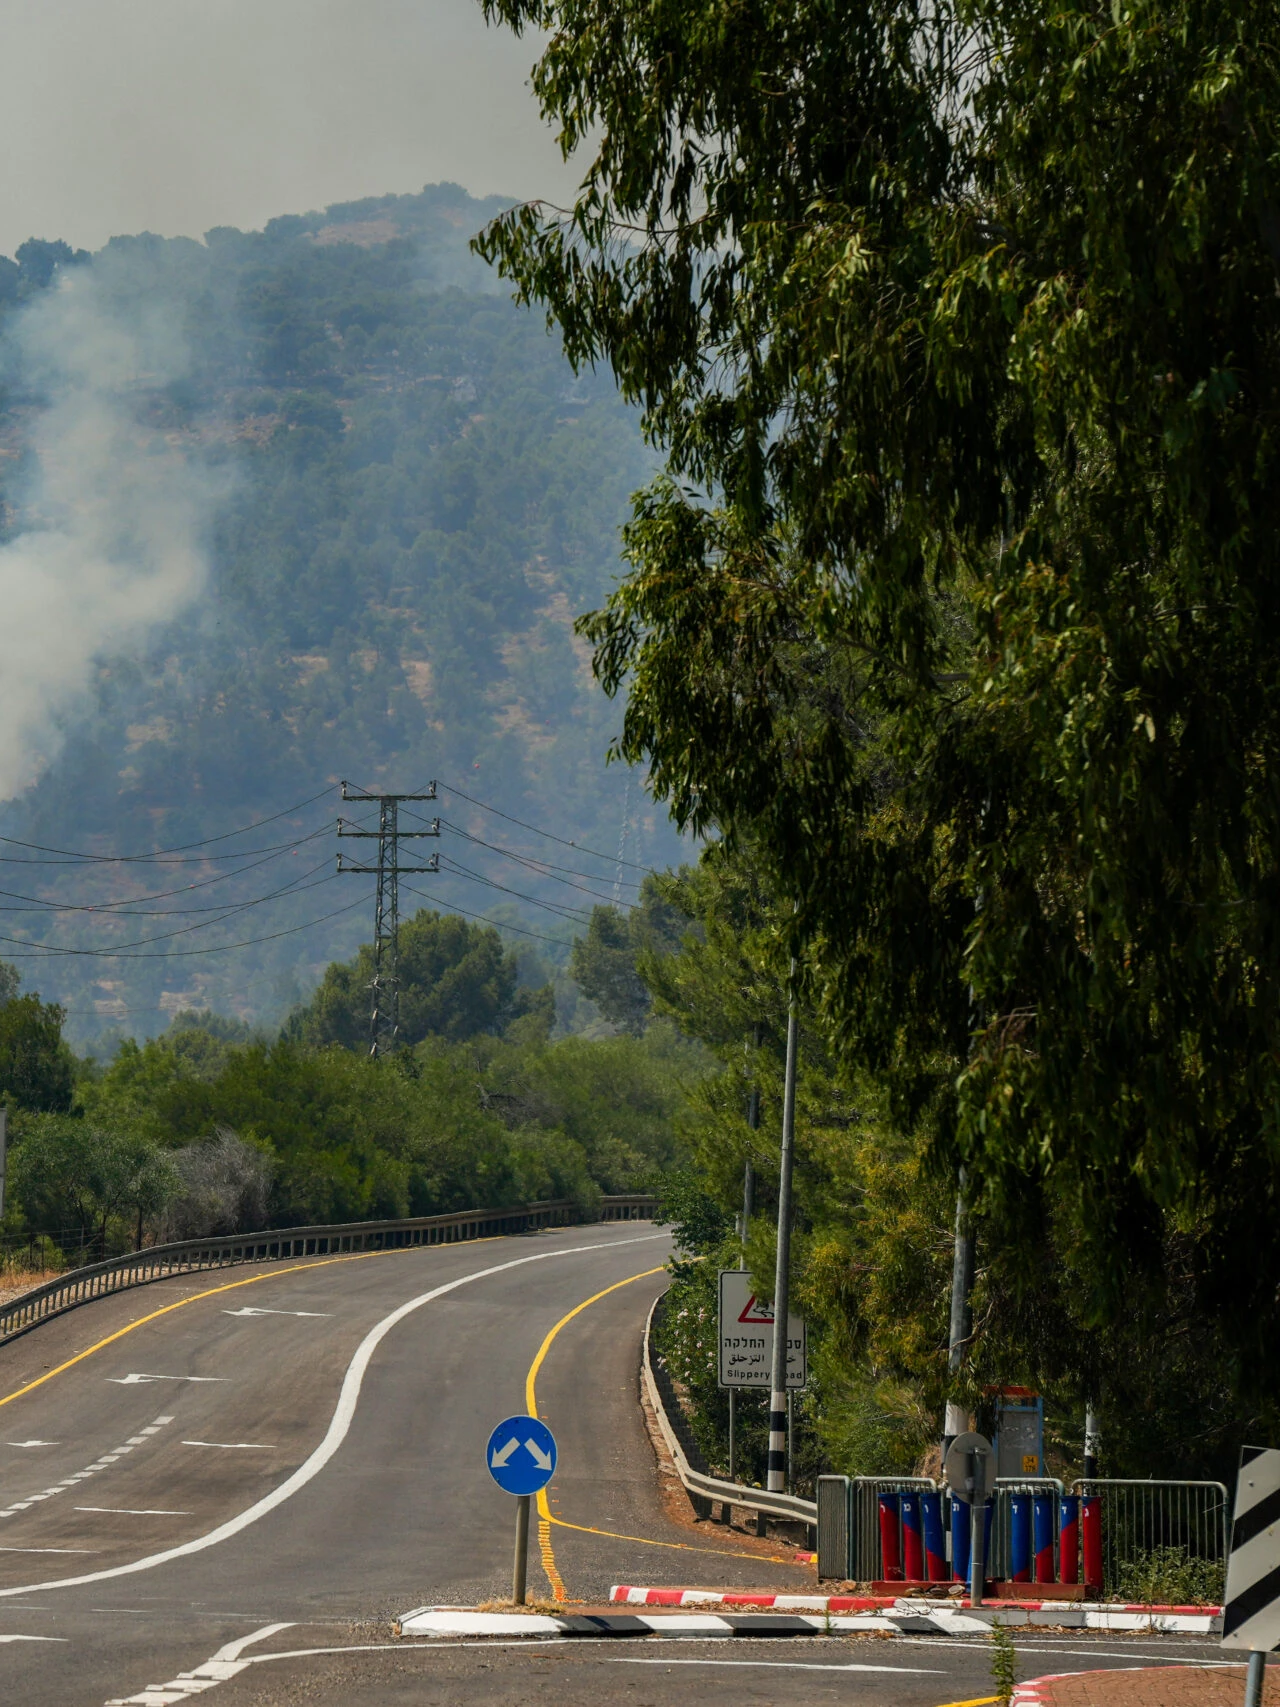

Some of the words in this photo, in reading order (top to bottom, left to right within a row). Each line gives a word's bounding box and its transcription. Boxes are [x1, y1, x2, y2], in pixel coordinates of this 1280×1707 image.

[724, 1337, 765, 1349] החלקה
[727, 1369, 770, 1381] Slippery
[784, 1370, 802, 1379] oad
